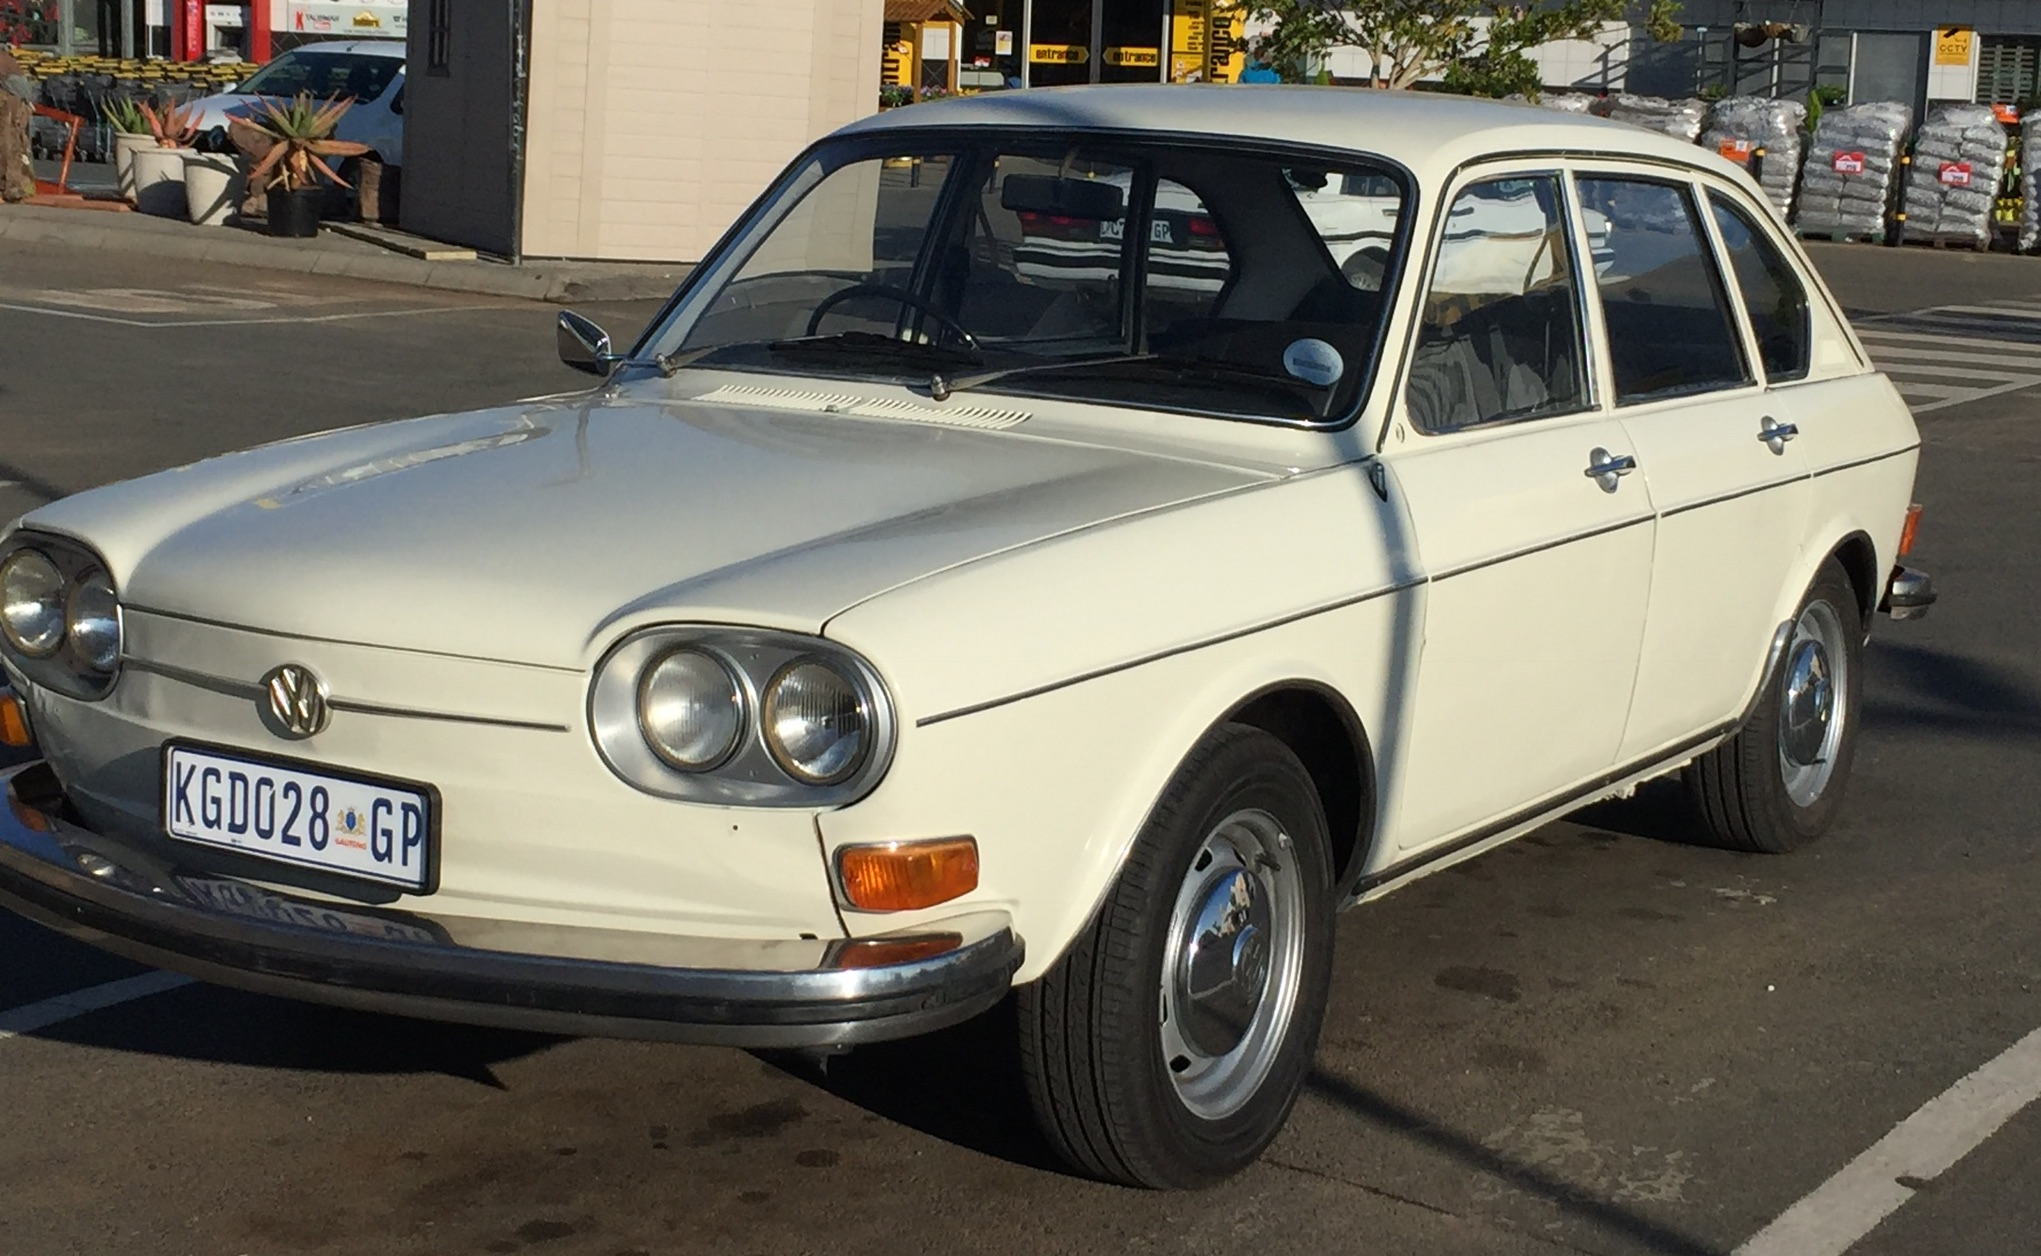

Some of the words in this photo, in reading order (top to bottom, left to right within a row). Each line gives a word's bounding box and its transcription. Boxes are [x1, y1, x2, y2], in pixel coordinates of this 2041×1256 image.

[1036, 48, 1079, 60] entrance
[1940, 44, 1967, 52] CCTV
[1113, 50, 1156, 63] entrance
[1154, 223, 1169, 239] GP
[175, 761, 329, 851] KGD028
[371, 797, 422, 867] GP
